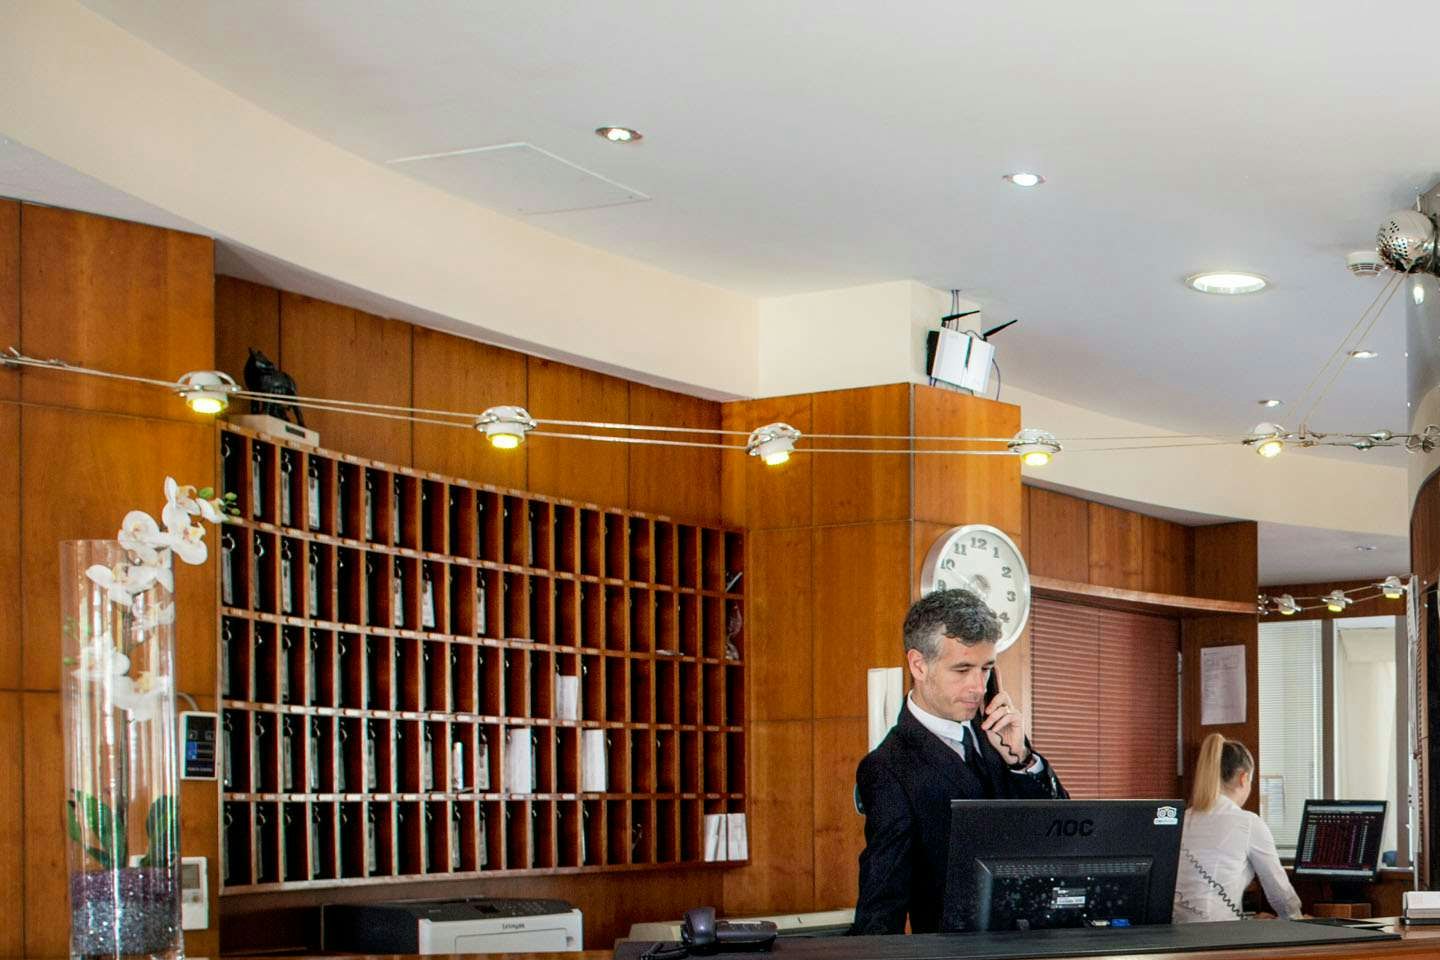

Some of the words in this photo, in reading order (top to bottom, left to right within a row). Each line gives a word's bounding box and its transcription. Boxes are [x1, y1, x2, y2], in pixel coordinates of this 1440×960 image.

[954, 541, 967, 556] 11
[970, 537, 988, 550] 12
[993, 546, 1000, 559] 1
[940, 558, 955, 570] 10
[1002, 566, 1012, 579] 2
[1007, 590, 1017, 602] 3
[998, 611, 1010, 623] 4
[1045, 819, 1094, 837] AOC
